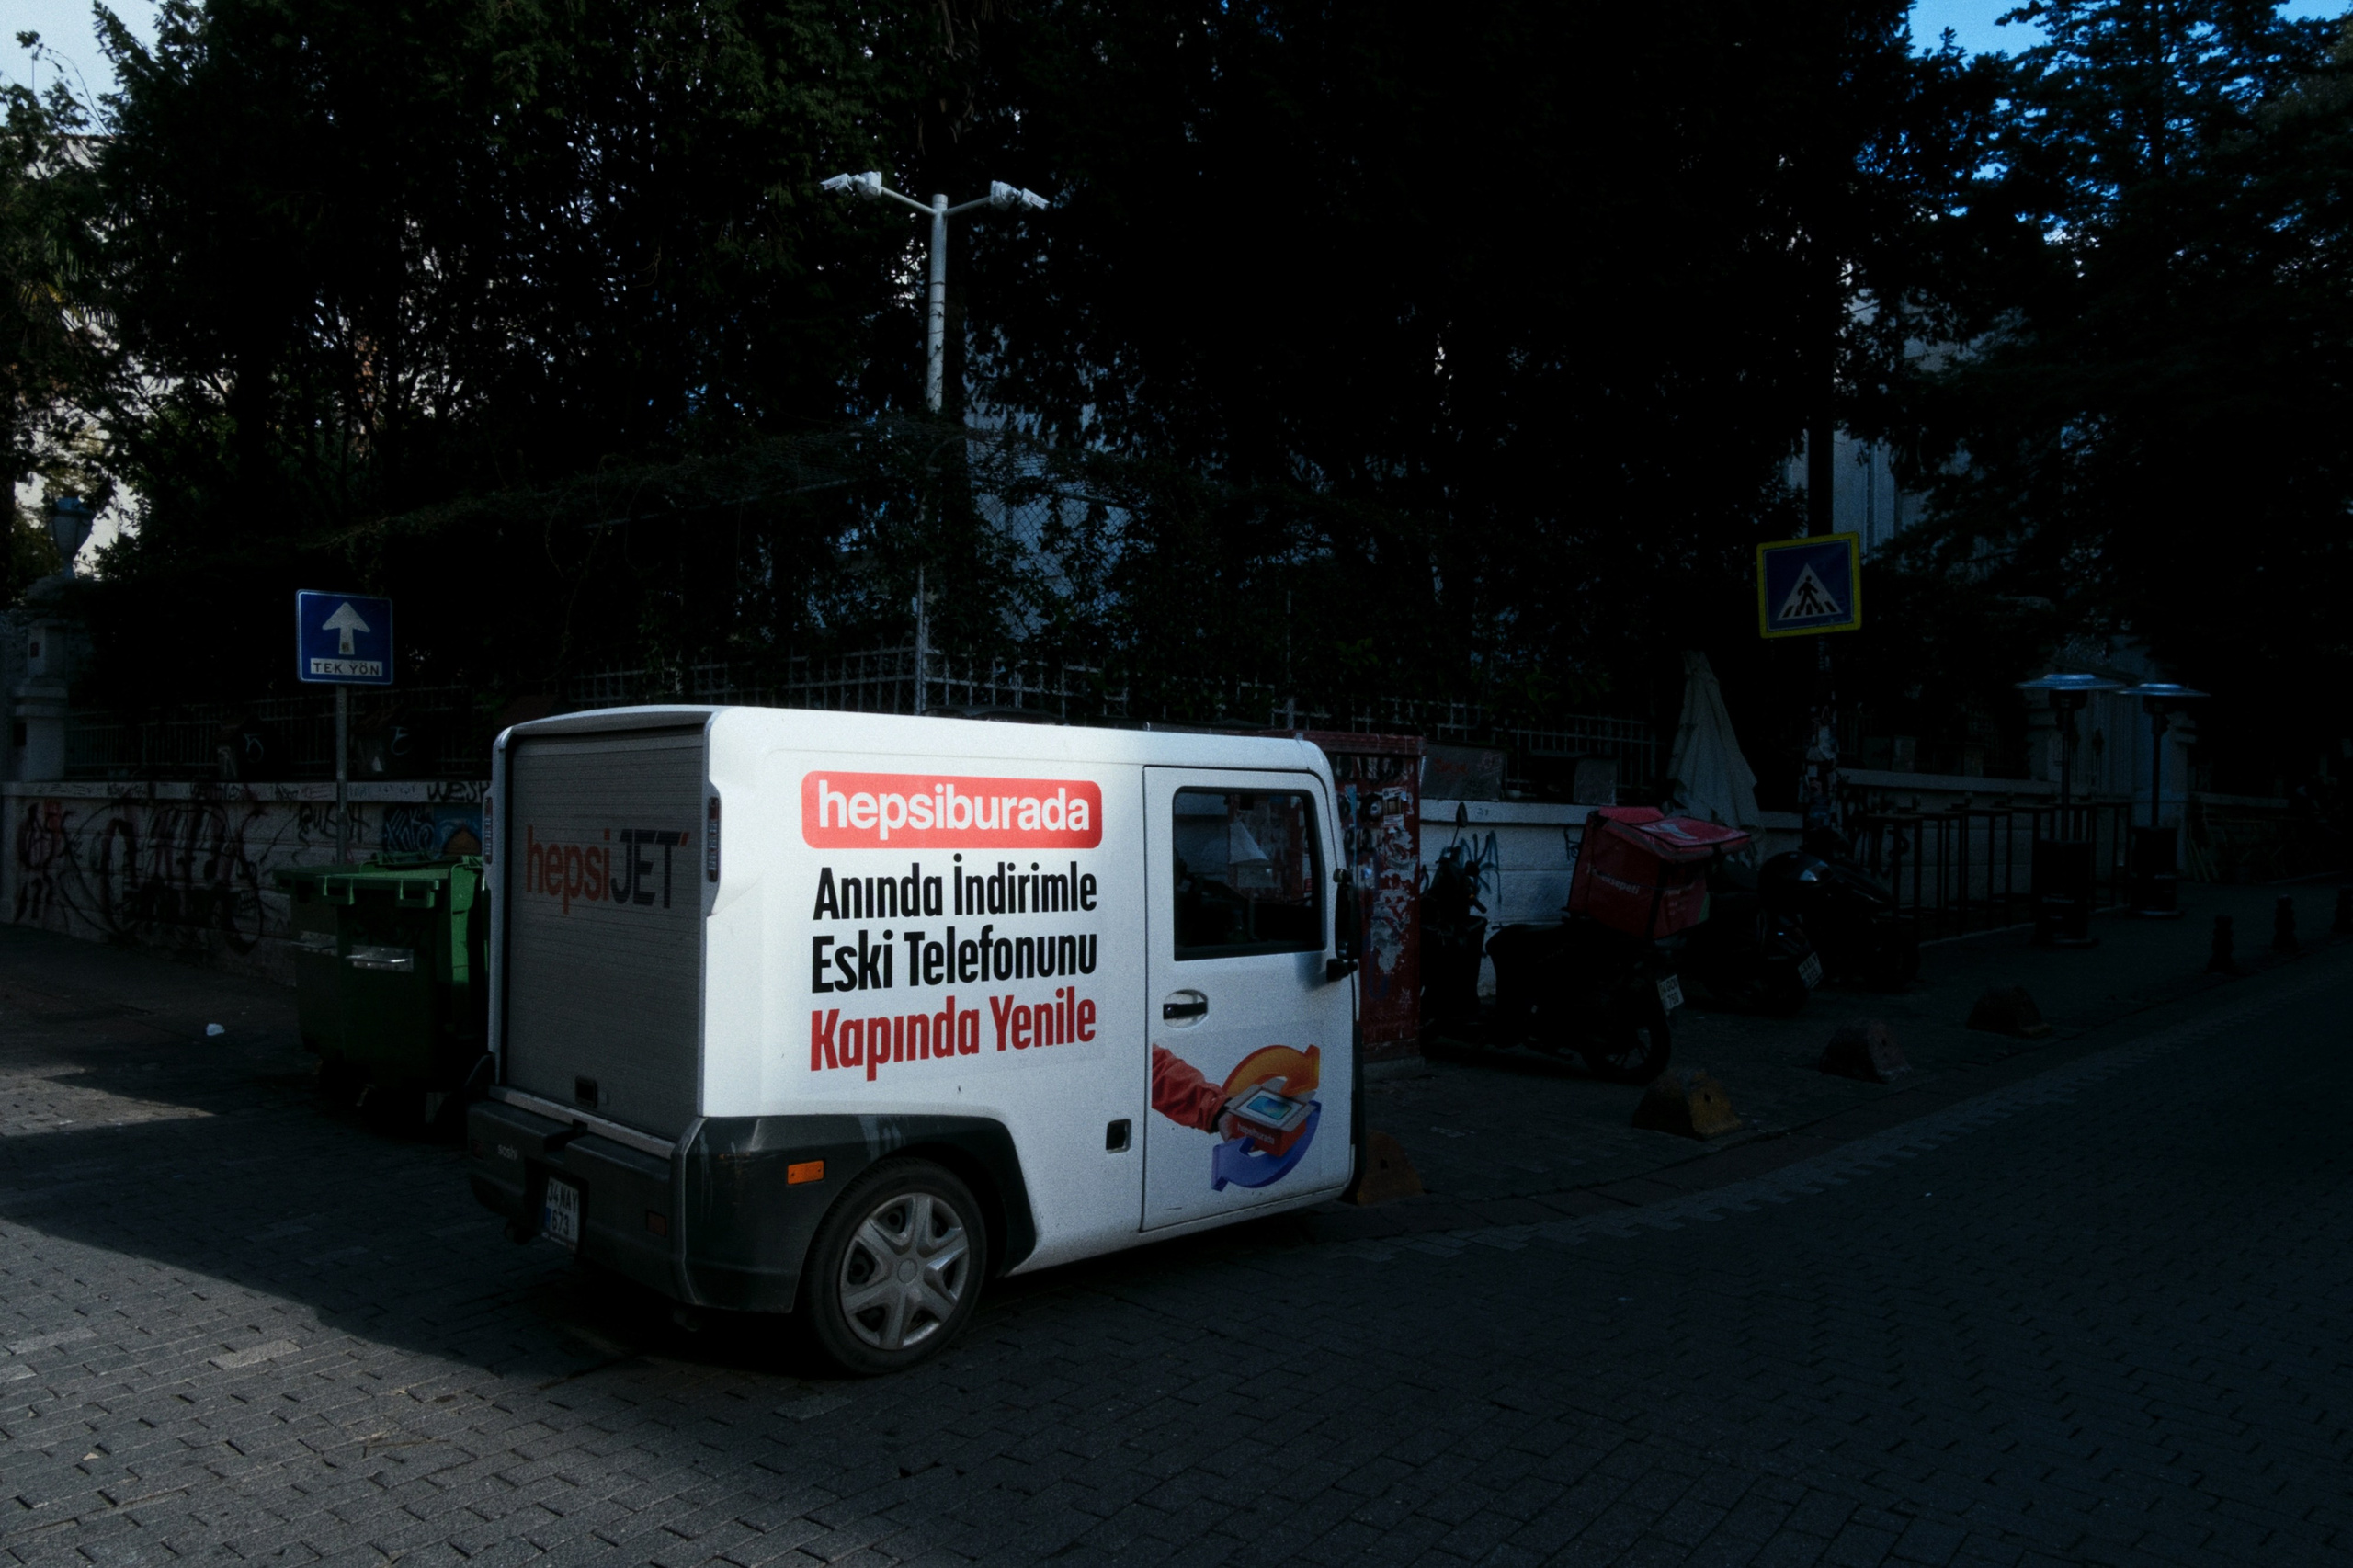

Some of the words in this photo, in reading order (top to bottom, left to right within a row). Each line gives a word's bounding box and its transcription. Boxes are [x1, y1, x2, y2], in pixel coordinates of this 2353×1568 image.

[313, 662, 342, 674] TEK
[348, 662, 379, 676] YÖN
[818, 778, 1091, 841] hepsiburada
[526, 824, 689, 915] hepsiJET
[812, 861, 944, 921] Anında
[952, 852, 1097, 916] İndirimle
[811, 928, 894, 994] Eski
[903, 923, 1097, 988] Telefonunu
[809, 994, 981, 1083] Kapında
[988, 985, 1097, 1052] Yenile
[551, 1209, 570, 1236] 673
